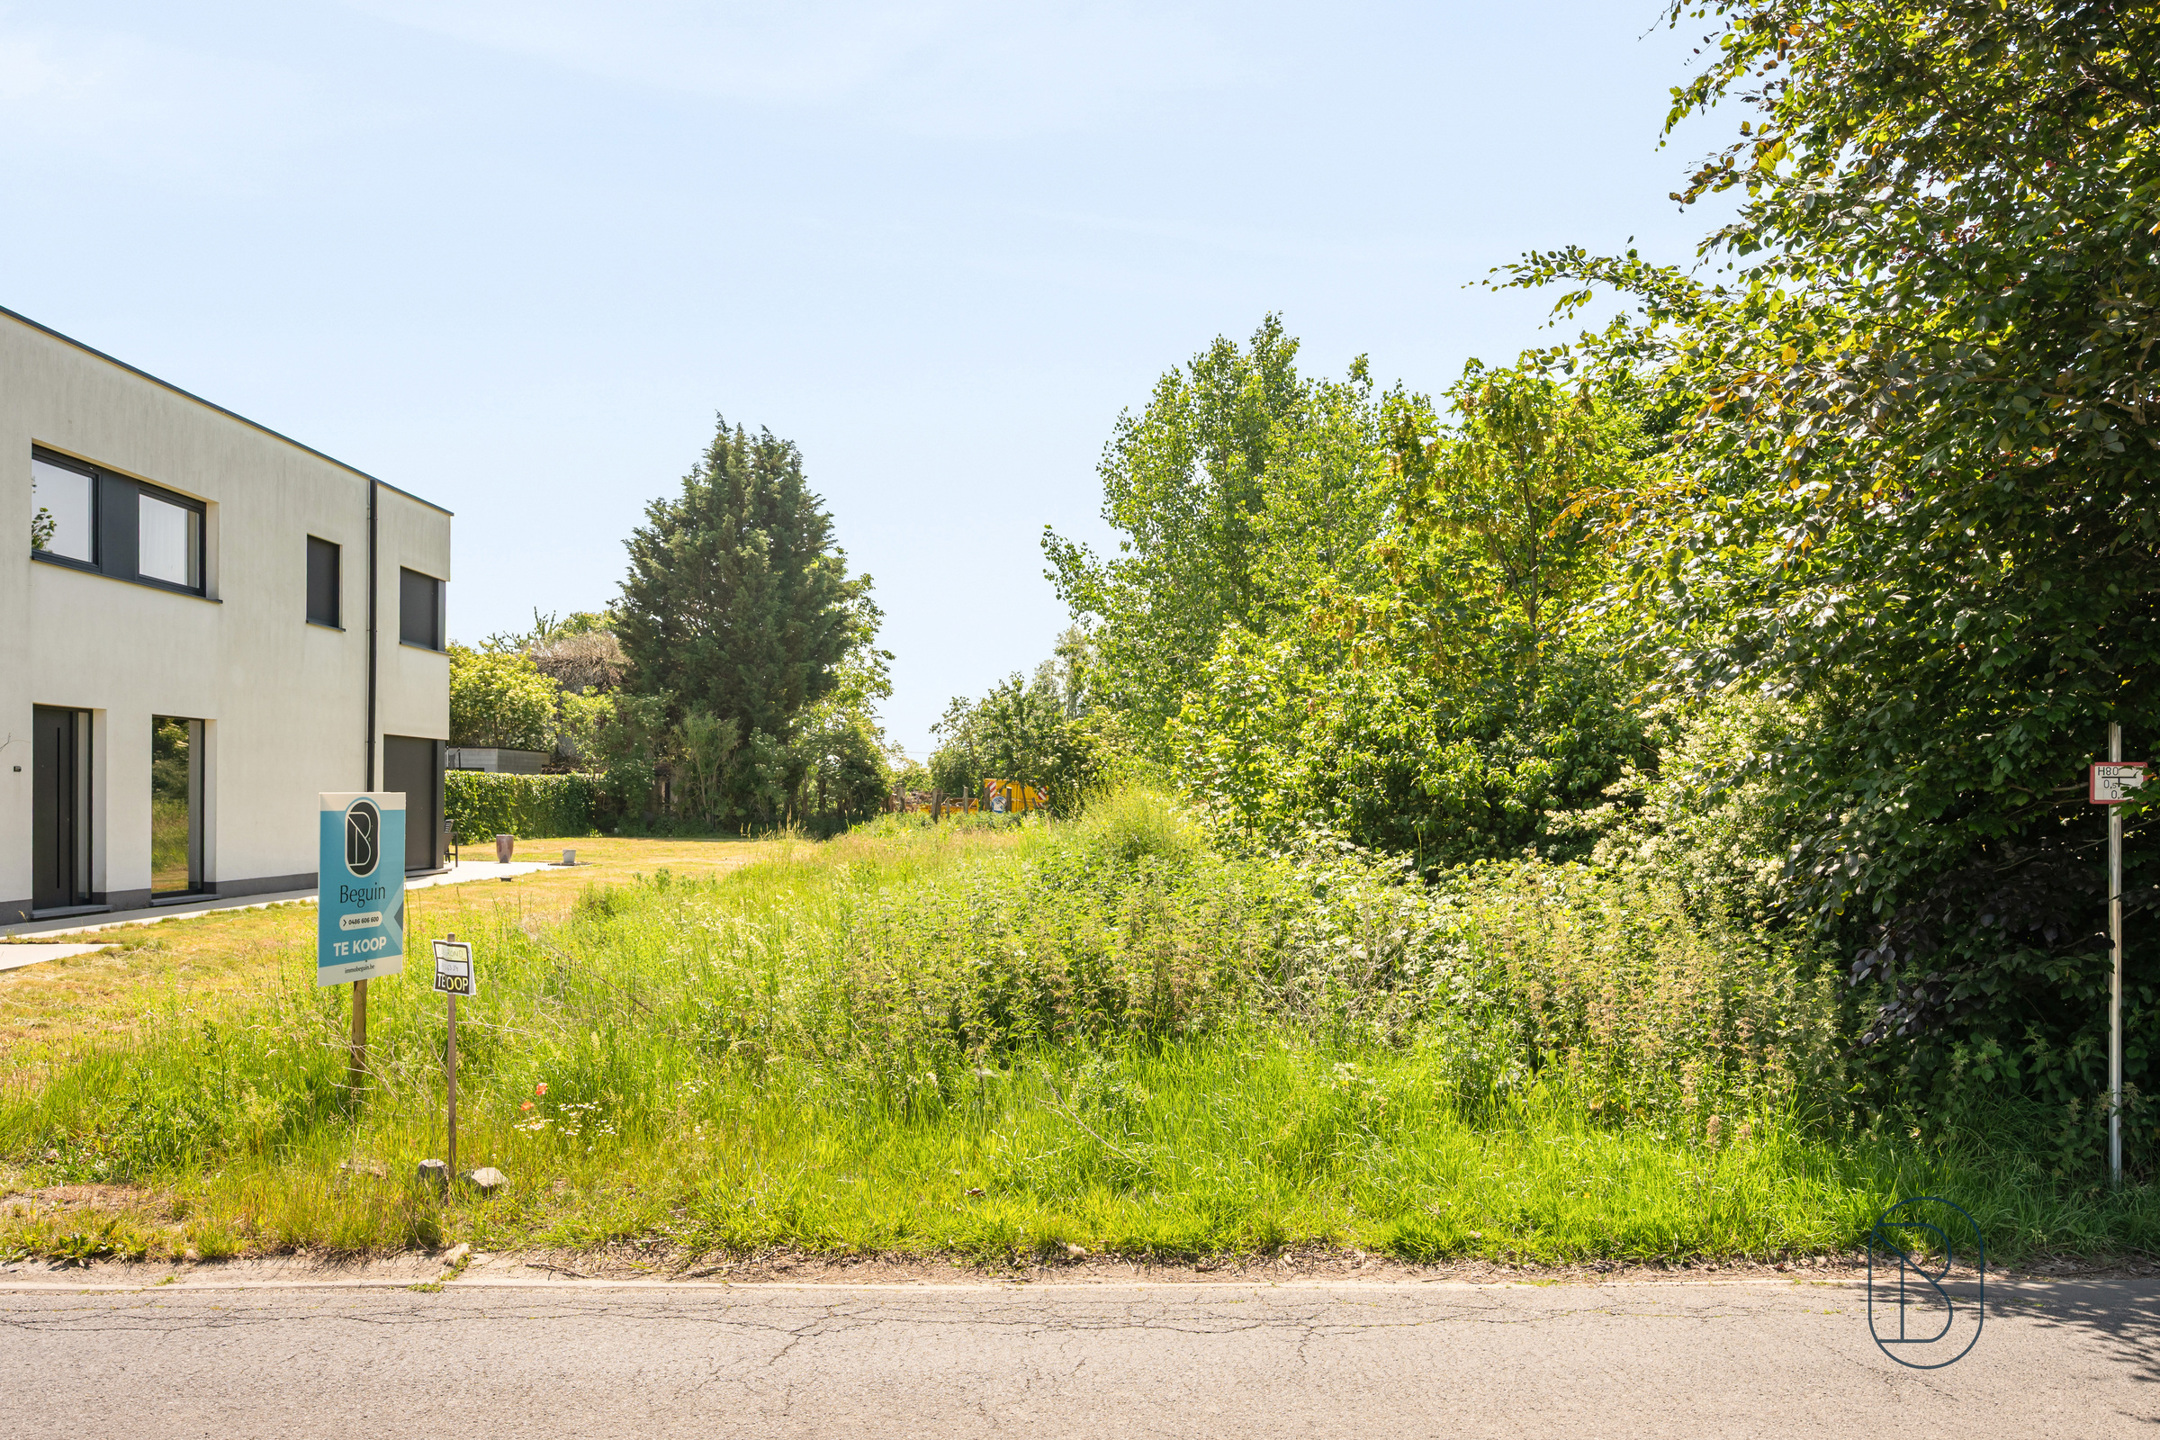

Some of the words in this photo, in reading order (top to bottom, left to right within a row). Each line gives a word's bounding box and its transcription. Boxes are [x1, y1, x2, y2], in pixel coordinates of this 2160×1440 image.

[340, 882, 386, 908] Beguin
[333, 941, 349, 956] TE
[352, 936, 387, 954] KOOP
[344, 963, 375, 974] immobeguin.be
[437, 973, 446, 988] TE
[446, 976, 469, 991] OOP
